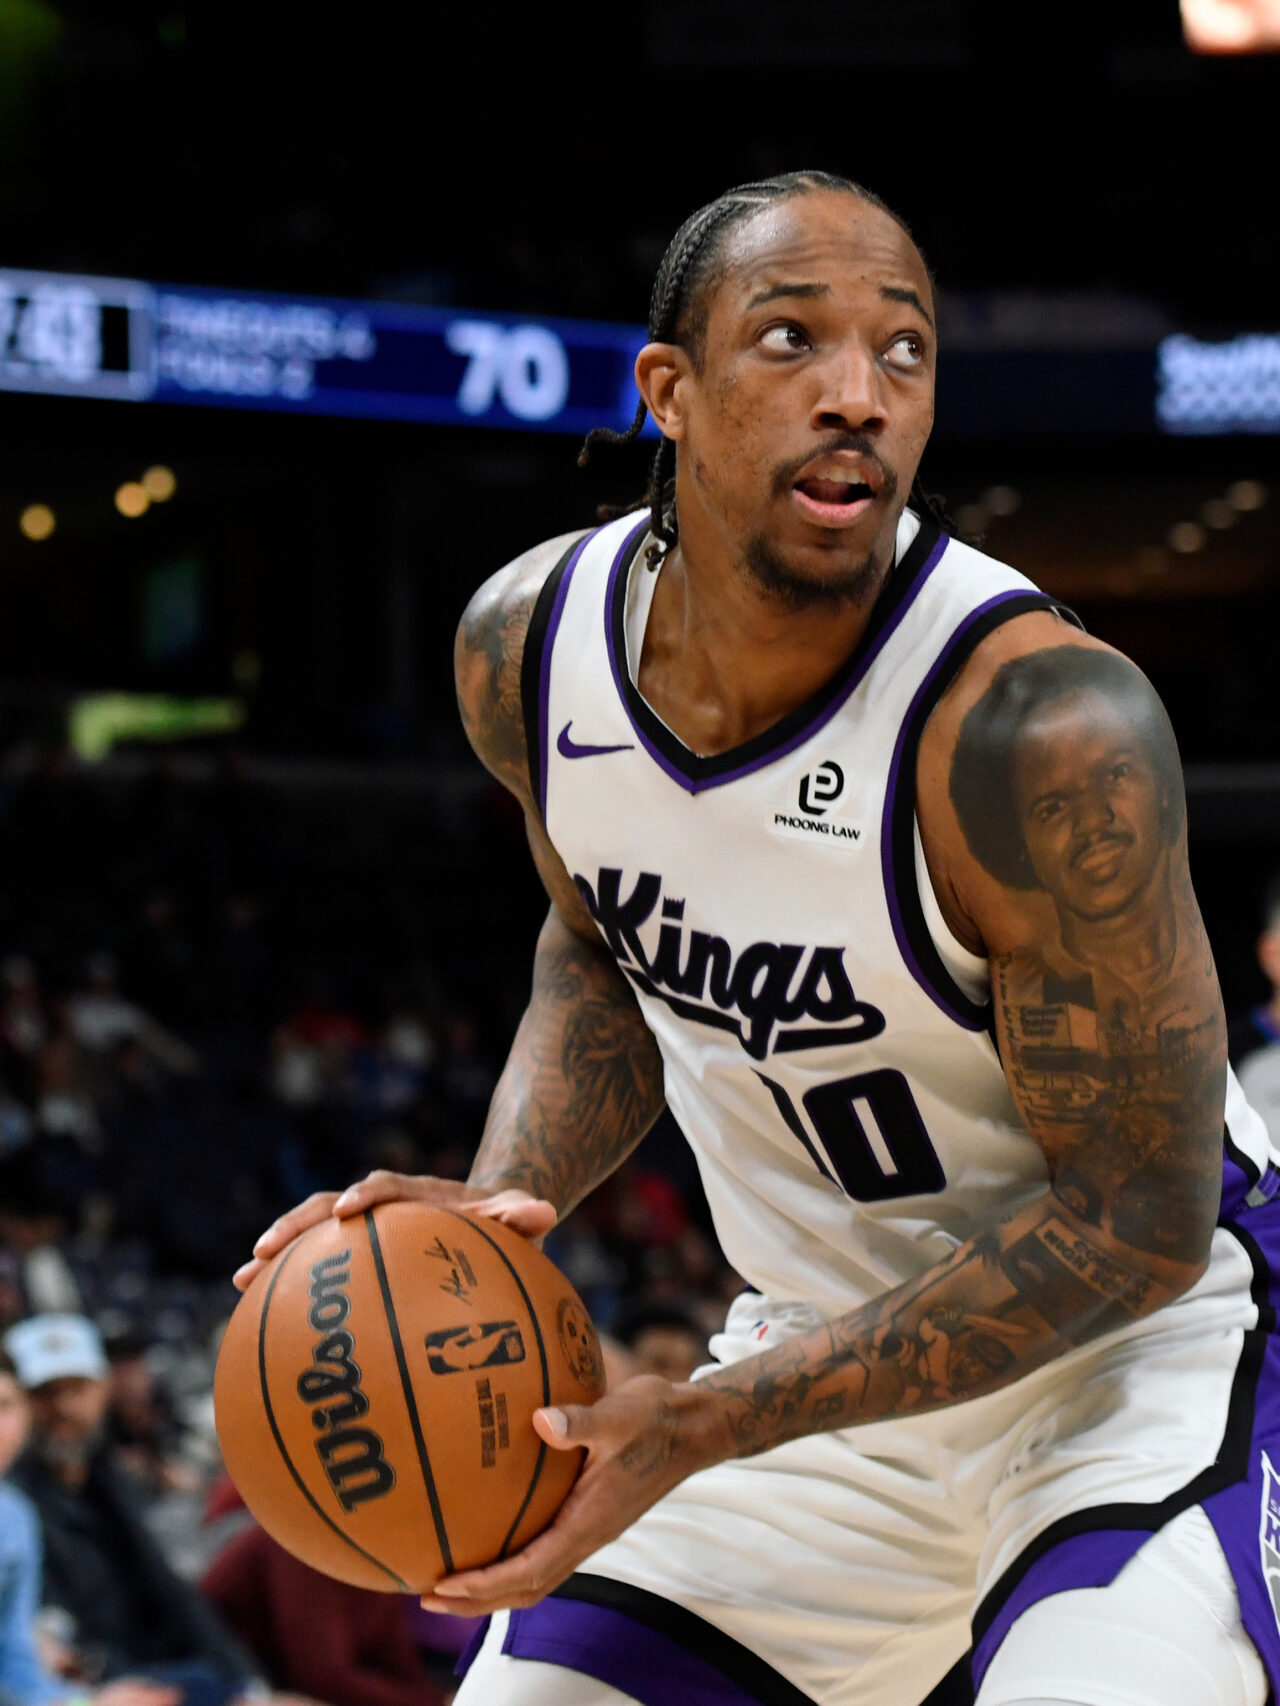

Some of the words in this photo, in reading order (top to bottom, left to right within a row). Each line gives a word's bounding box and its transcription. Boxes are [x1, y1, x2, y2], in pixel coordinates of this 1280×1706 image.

[446, 320, 569, 421] 70
[774, 813, 830, 835] PHOONG
[831, 824, 861, 841] LAW
[573, 866, 887, 1061] Kings
[297, 1249, 396, 1514] Wilson
